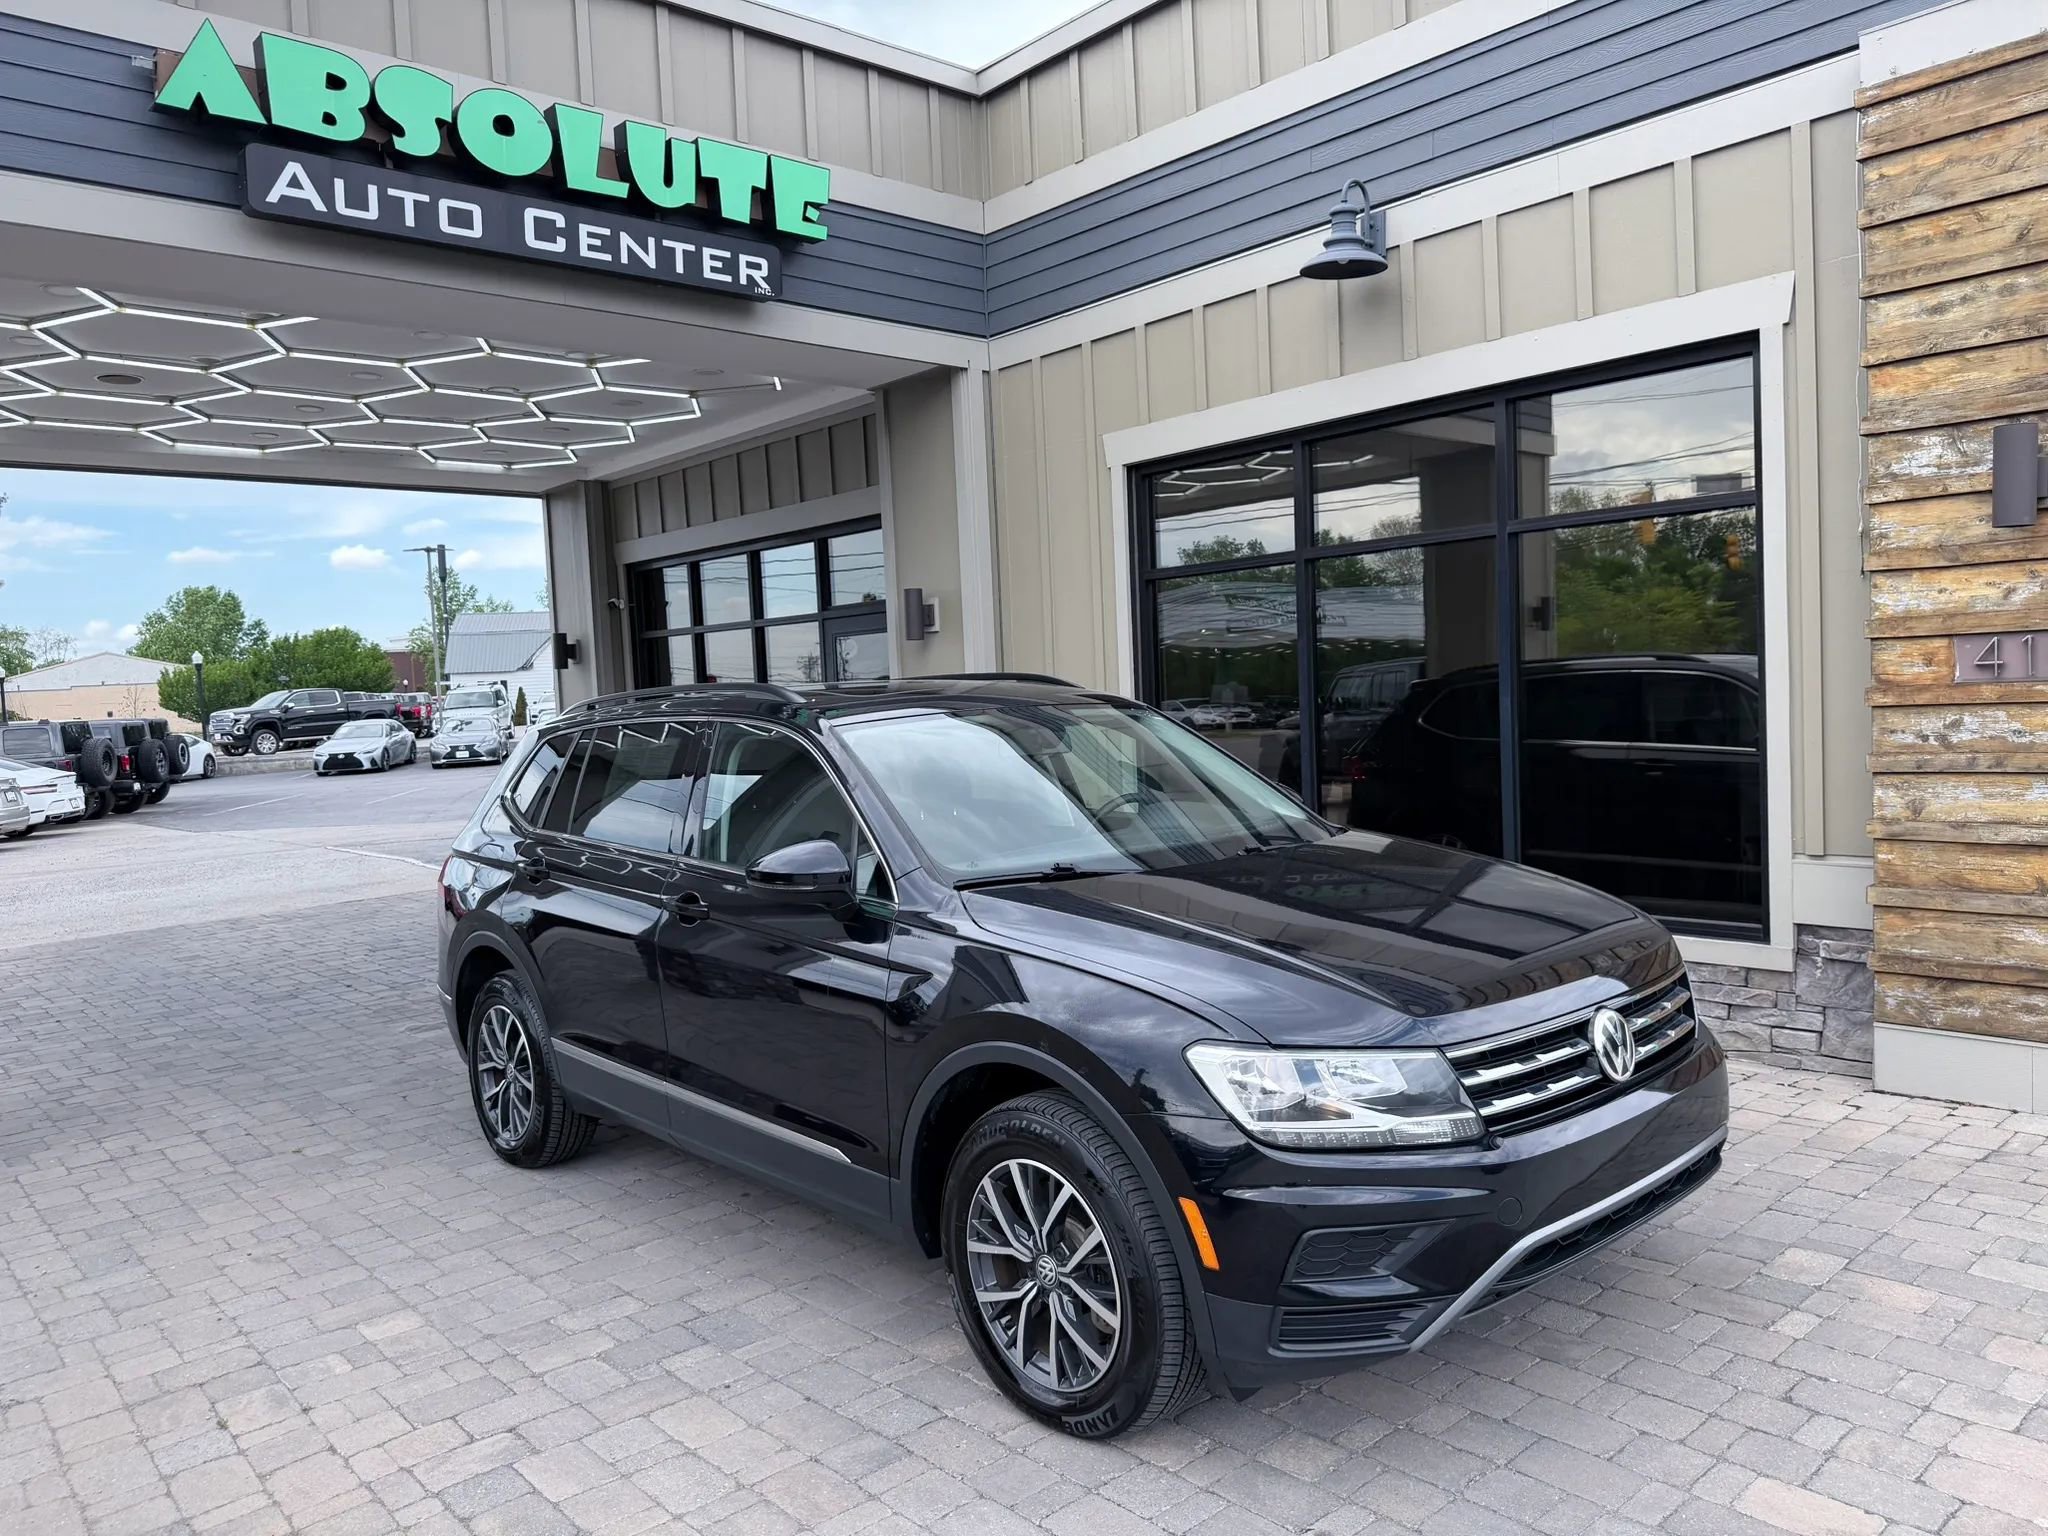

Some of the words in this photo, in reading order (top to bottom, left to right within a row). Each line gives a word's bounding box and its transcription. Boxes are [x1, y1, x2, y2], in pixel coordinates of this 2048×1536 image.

[155, 18, 830, 241] ABSOLUTE
[265, 161, 484, 239] AUTO
[524, 207, 770, 289] CENTER
[754, 286, 776, 297] INC.
[1973, 634, 2036, 677] 41
